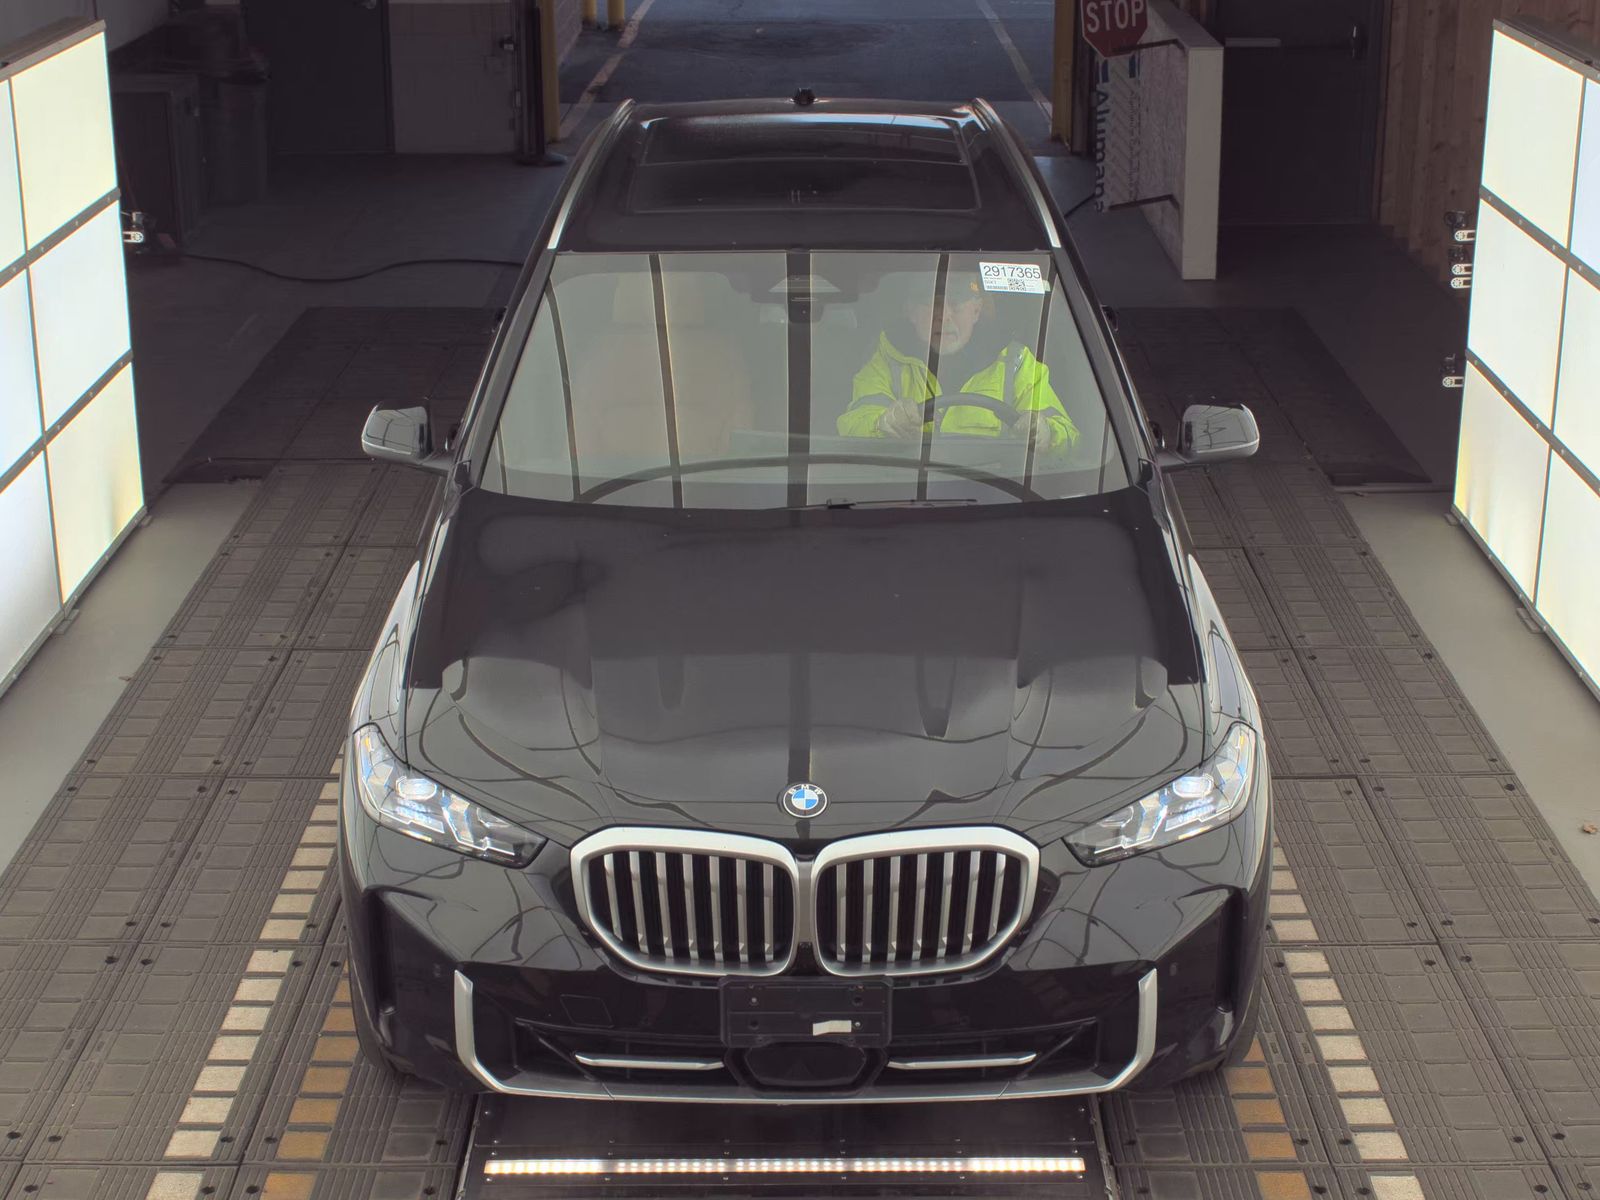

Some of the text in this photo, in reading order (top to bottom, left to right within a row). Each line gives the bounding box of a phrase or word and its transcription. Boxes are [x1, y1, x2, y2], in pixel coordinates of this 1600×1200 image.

[1086, 0, 1144, 33] STOP
[983, 265, 1041, 279] 2917365
[787, 784, 823, 795] BMW
